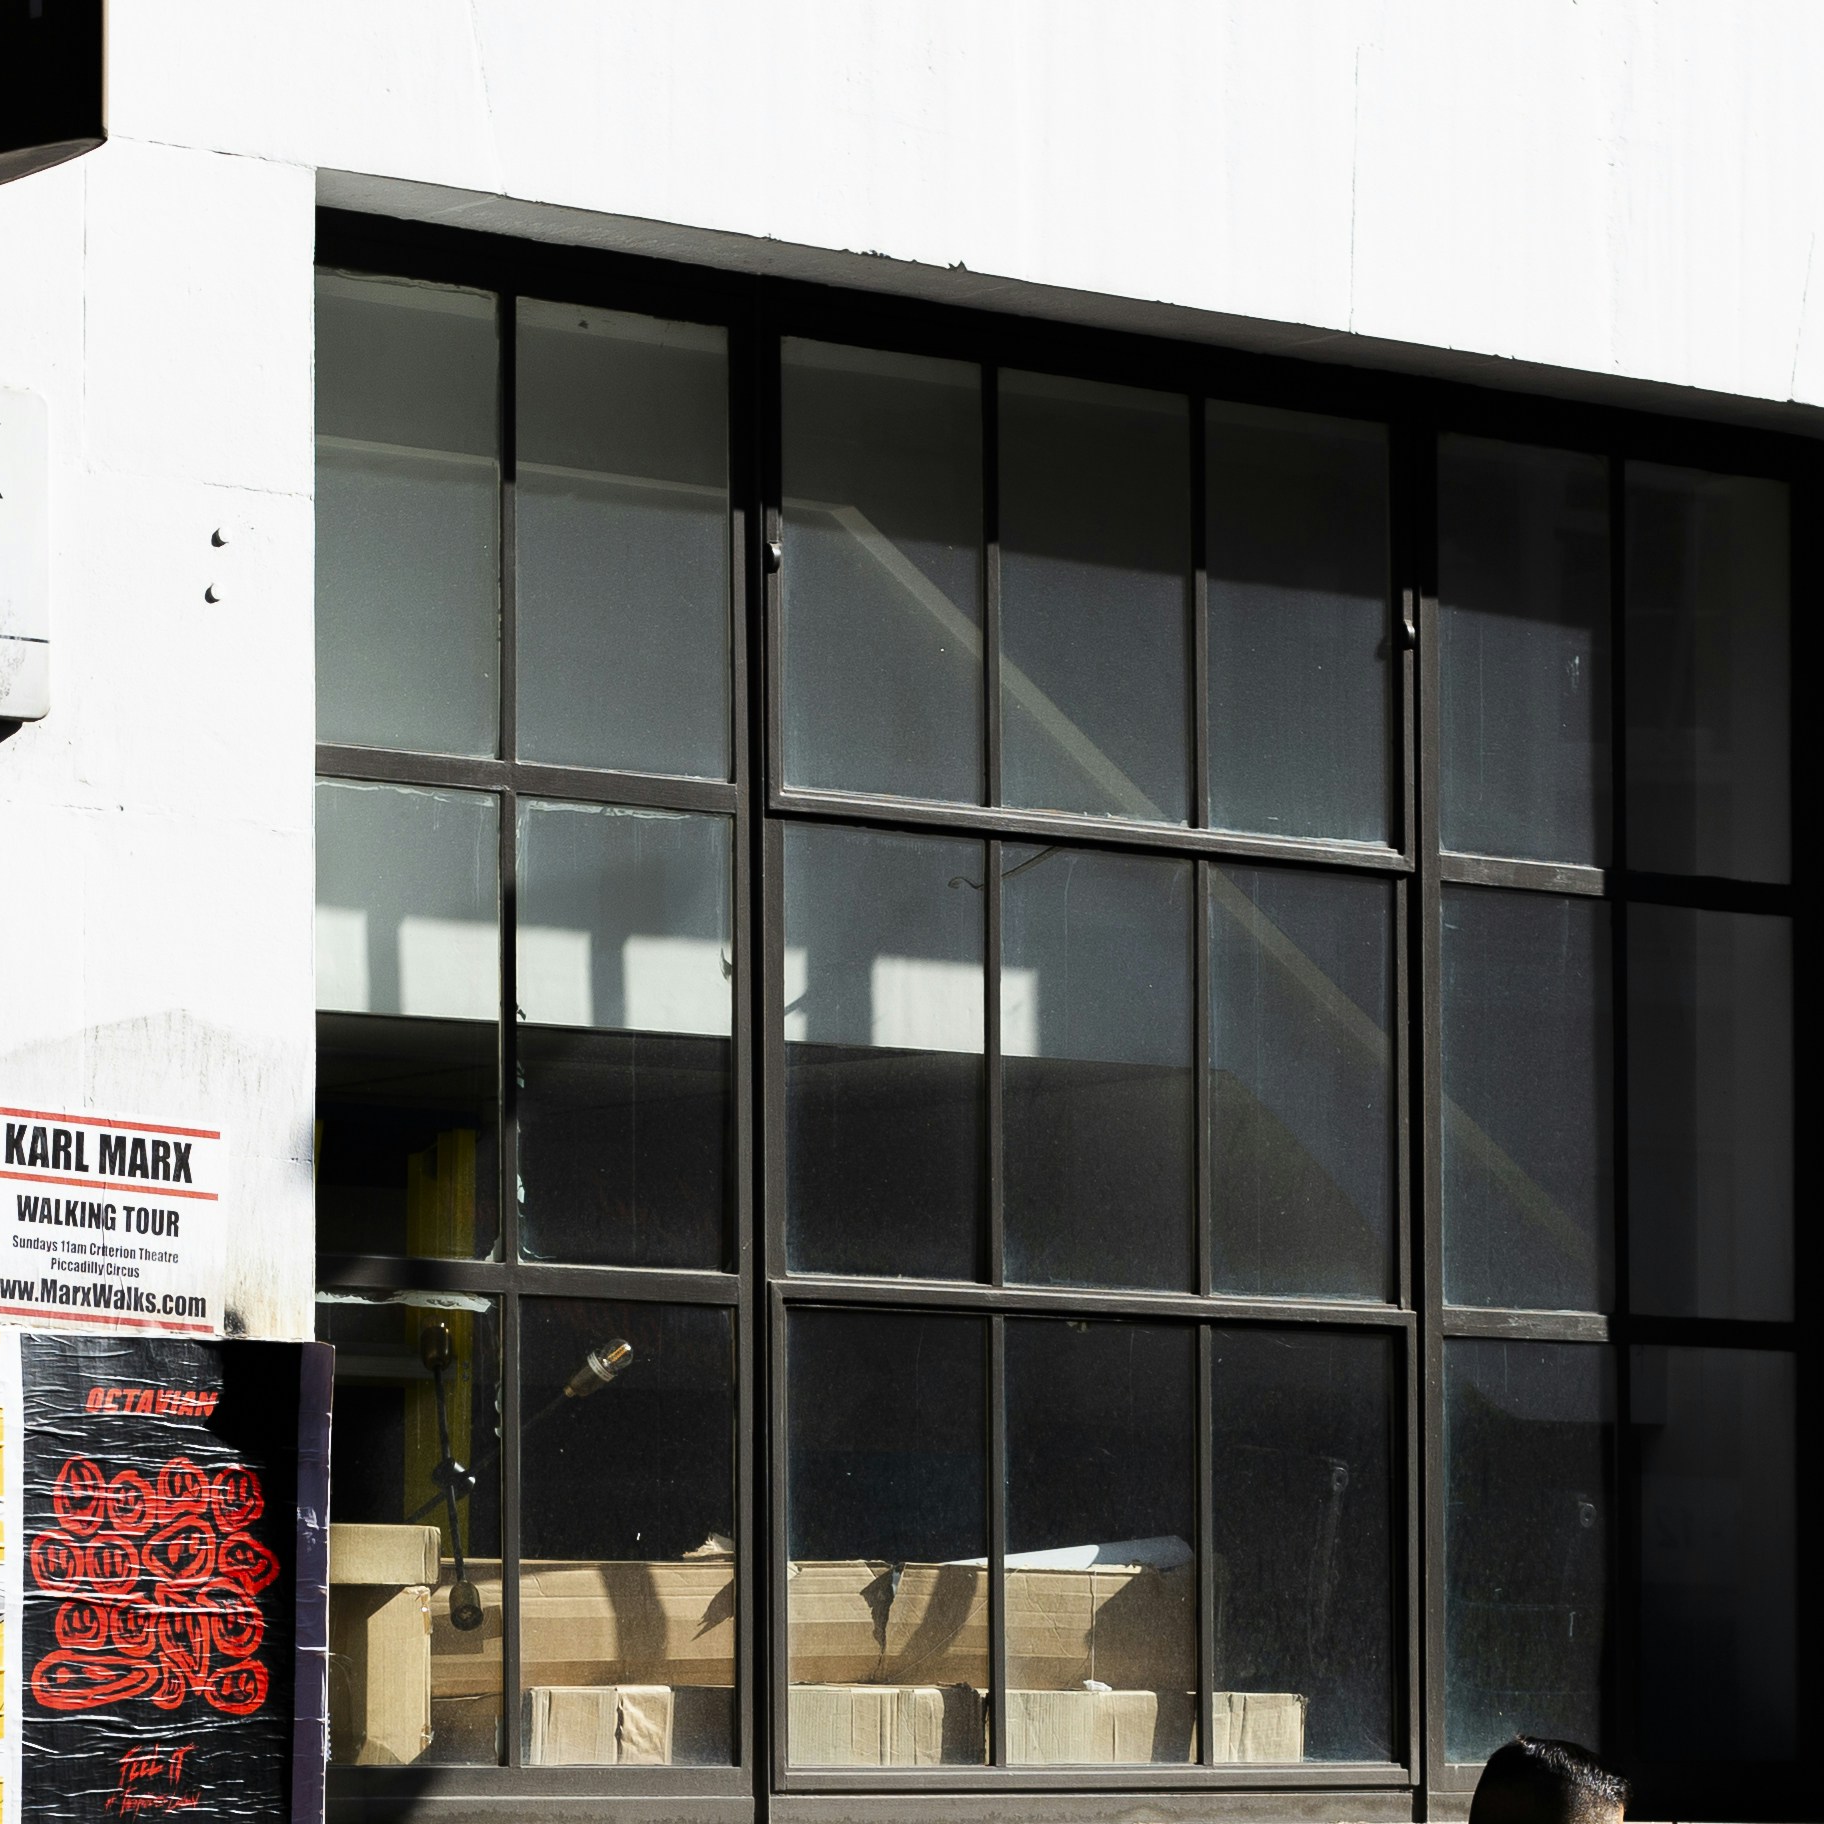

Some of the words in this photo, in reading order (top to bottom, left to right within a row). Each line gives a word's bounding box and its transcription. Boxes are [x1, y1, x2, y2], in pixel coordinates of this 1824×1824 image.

[4, 1123, 89, 1174] KARL
[97, 1135, 194, 1184] MARX
[16, 1194, 117, 1234] WALKING
[122, 1205, 181, 1239] TOUR
[12, 1234, 59, 1255] Sundays
[60, 1239, 87, 1256] 11am
[88, 1241, 137, 1261] Criterion
[138, 1248, 180, 1265] Theatre
[50, 1257, 104, 1278] Piccadilly
[104, 1262, 140, 1280] Circus
[85, 1387, 219, 1419] OCTAVIAN
